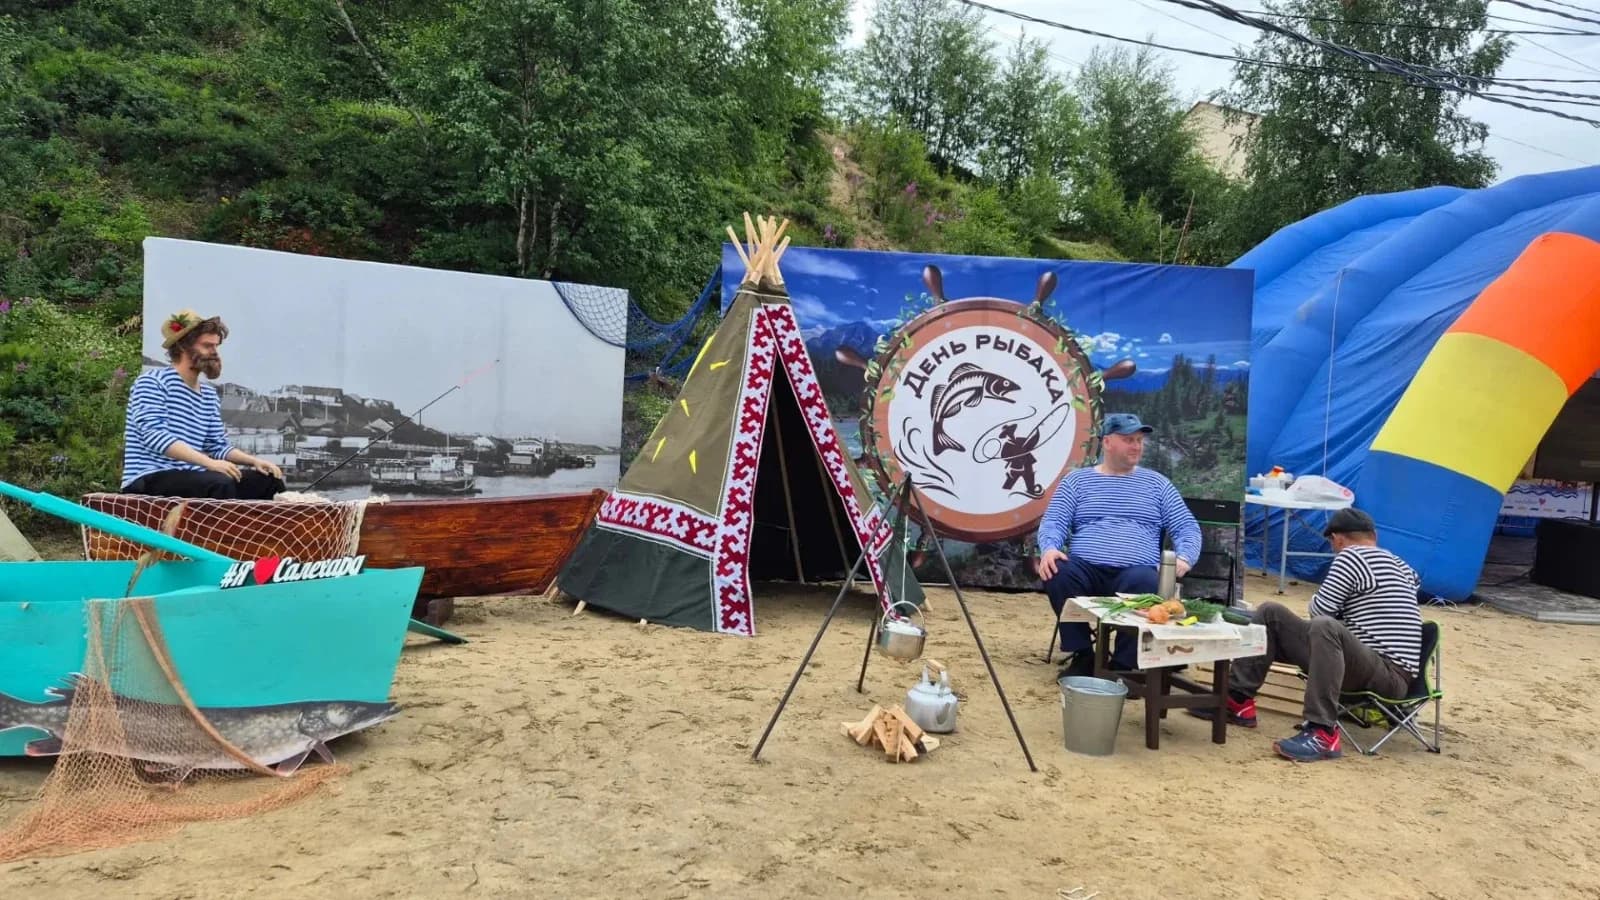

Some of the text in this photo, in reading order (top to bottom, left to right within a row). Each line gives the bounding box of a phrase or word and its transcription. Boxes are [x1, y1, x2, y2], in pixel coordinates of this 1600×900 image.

[903, 334, 1064, 404] ДЕНЬ РЫБАКА
[220, 555, 366, 588] #Я Салехард
